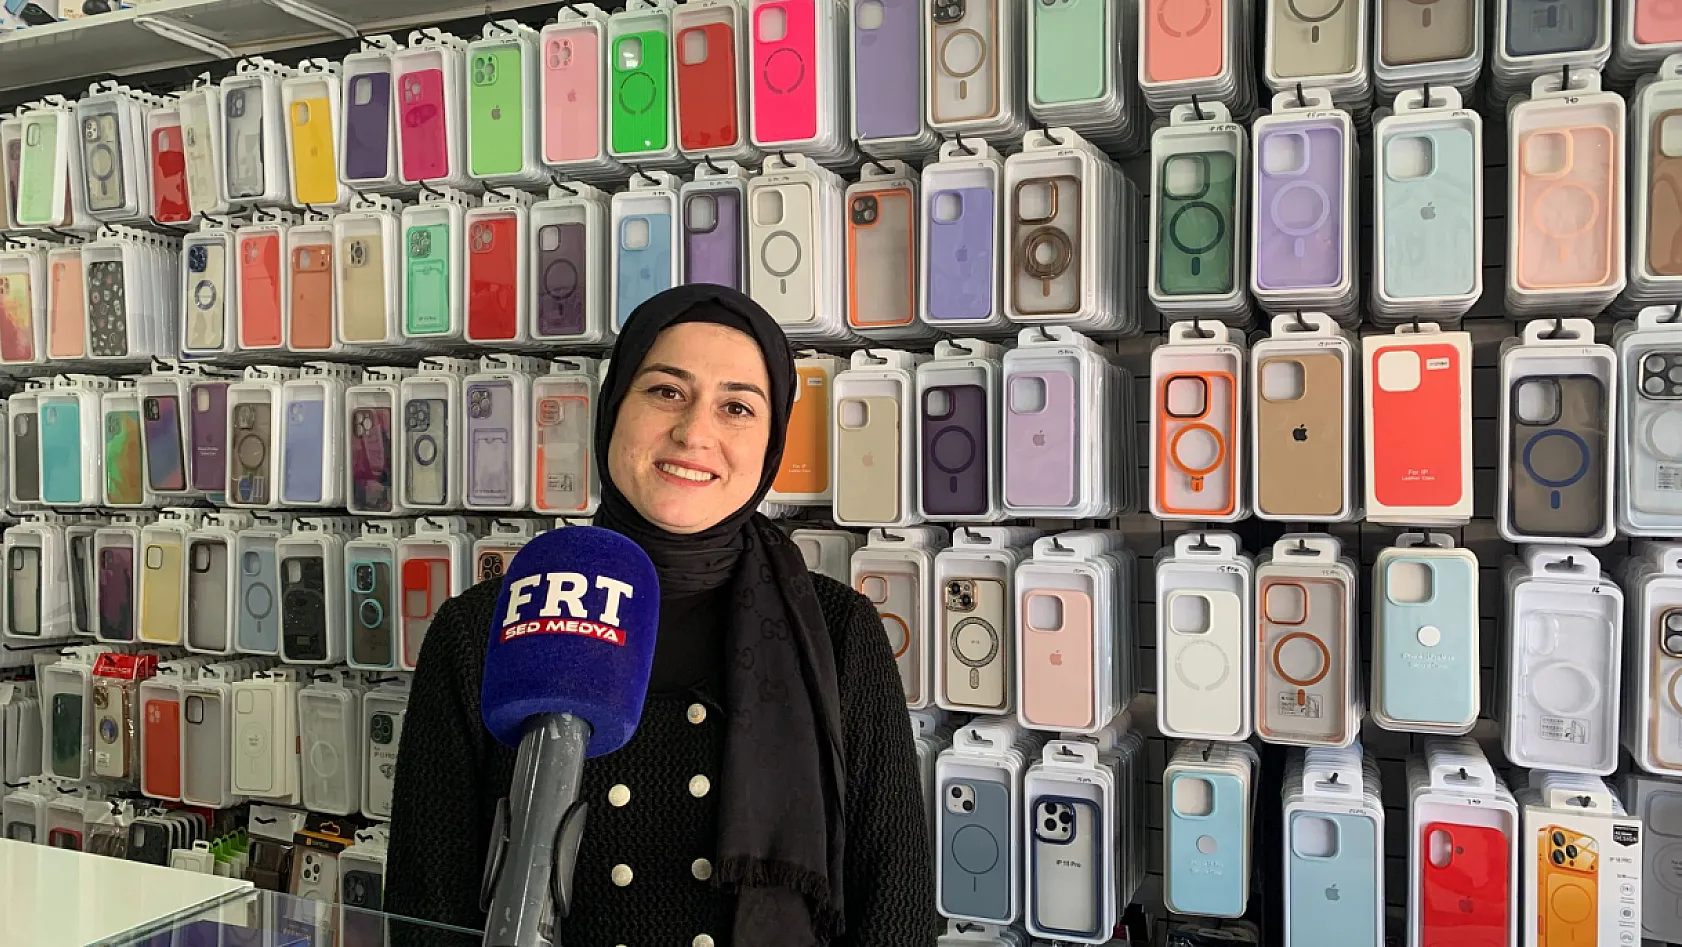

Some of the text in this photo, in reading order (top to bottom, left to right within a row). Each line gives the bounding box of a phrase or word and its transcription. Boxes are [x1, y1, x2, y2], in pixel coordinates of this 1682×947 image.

[502, 572, 633, 627] FRT
[505, 619, 619, 643] SED MEDYA
